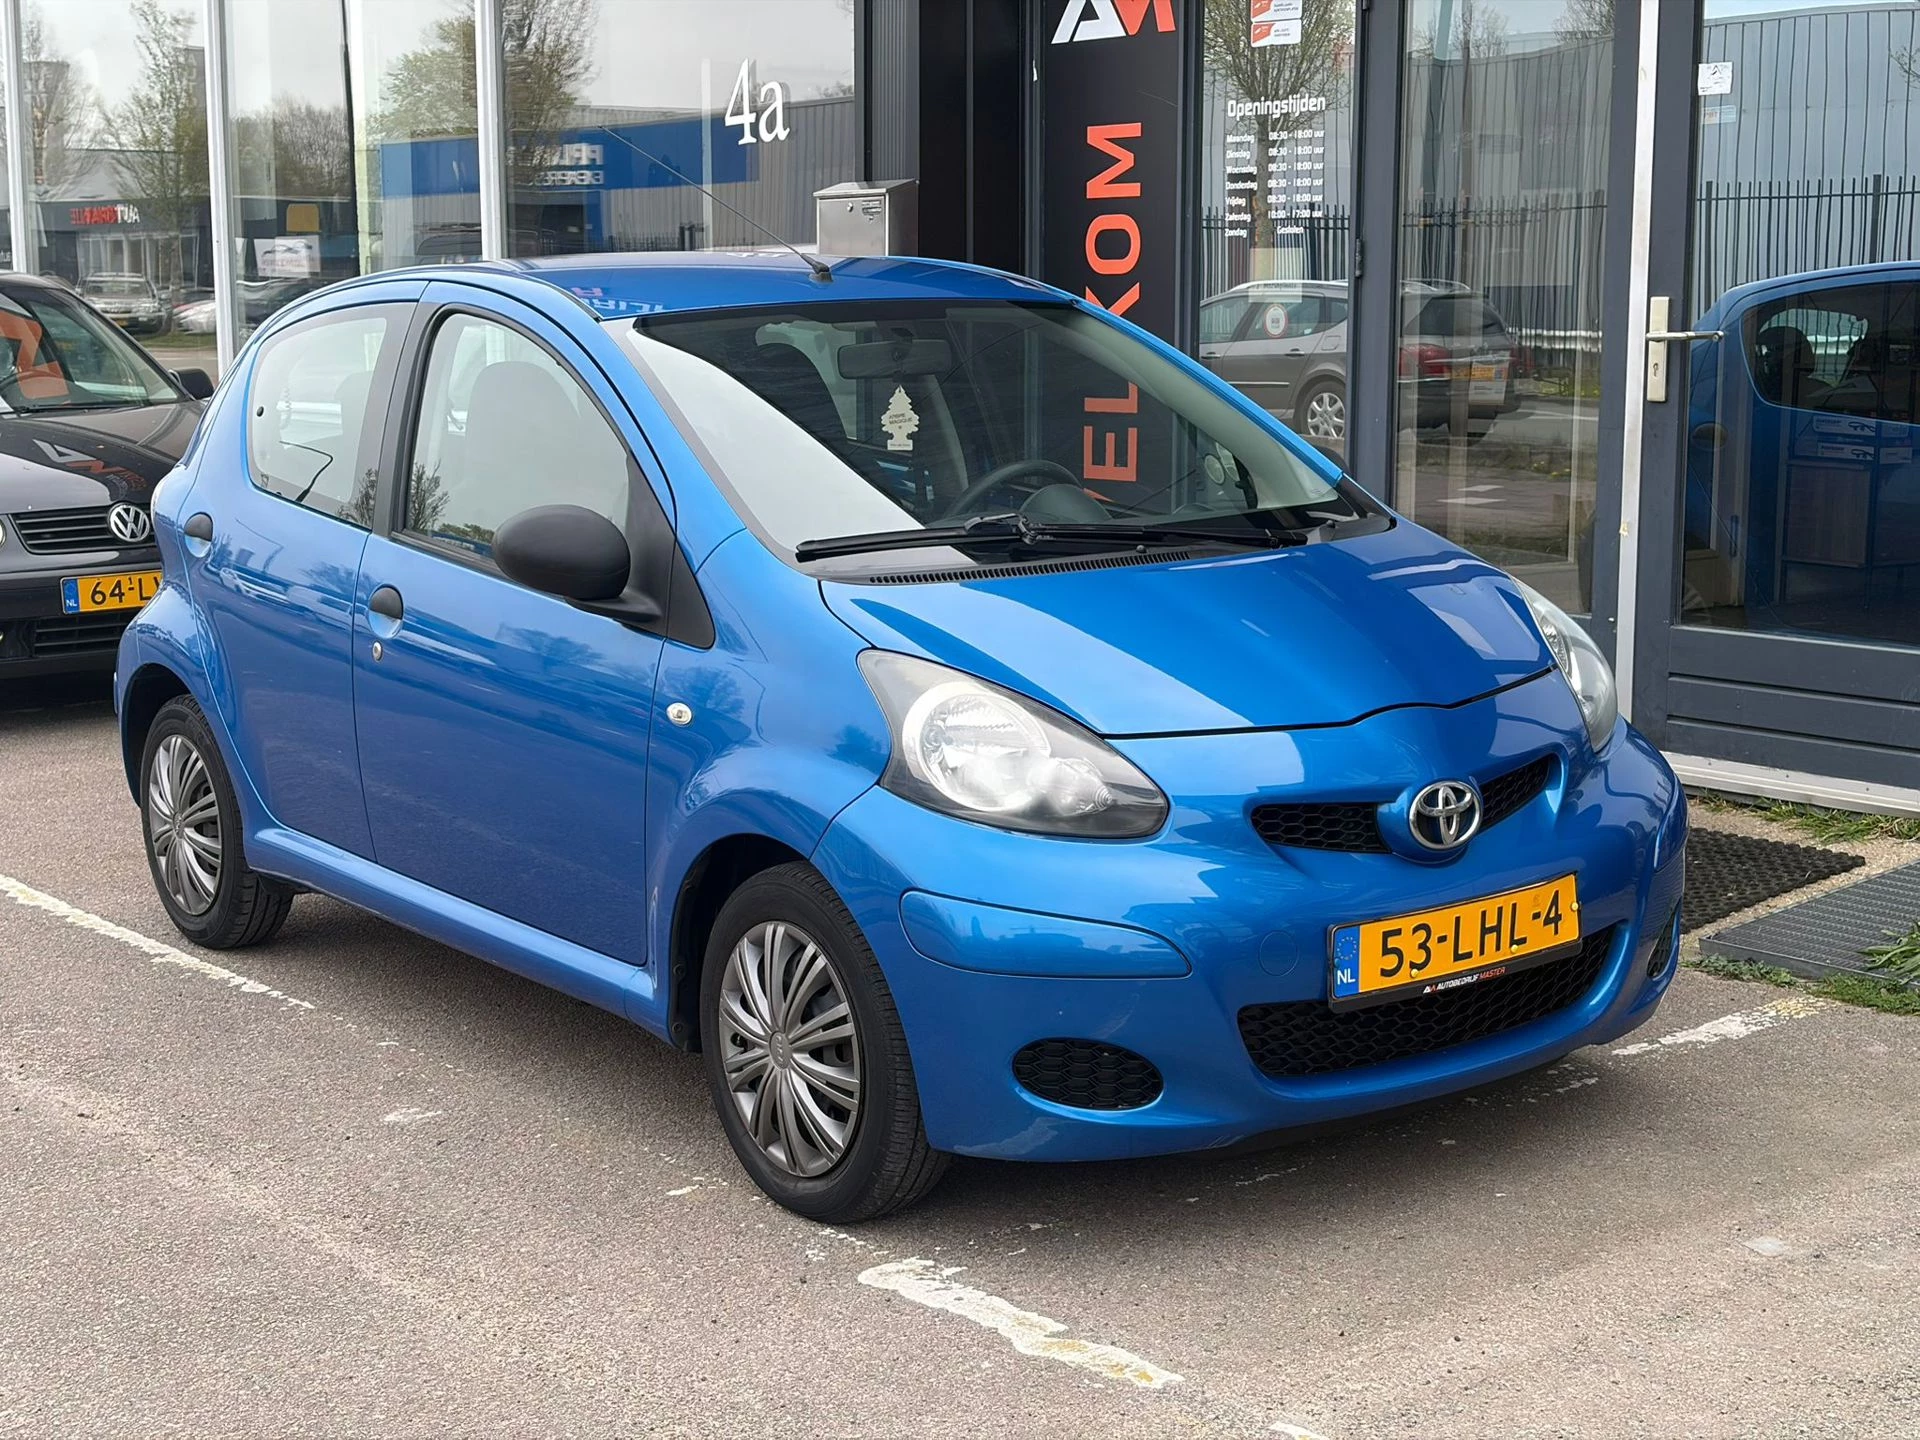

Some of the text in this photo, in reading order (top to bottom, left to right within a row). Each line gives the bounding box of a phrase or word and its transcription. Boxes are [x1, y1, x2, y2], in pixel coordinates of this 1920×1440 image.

[725, 58, 790, 146] 4a
[1227, 93, 1325, 121] Openingstijden
[1226, 133, 1254, 143] Maandag
[1313, 130, 1324, 138] uur
[1226, 150, 1251, 159] Dinsdag
[1226, 165, 1257, 174] Woensdag
[1225, 180, 1258, 190] Donderdag
[1312, 178, 1323, 186] uur
[1225, 196, 1246, 207] Vrijdag
[1312, 194, 1323, 202] uur
[1225, 212, 1251, 222] Zaterdag
[1225, 226, 1304, 238] Zondag Gesloten
[1083, 122, 1143, 502] ELOM
[66, 599, 78, 608] NL
[1380, 890, 1562, 978] 53-LHL-4
[1336, 968, 1356, 985] NL
[1436, 974, 1480, 990] AUTOBEDRIJF
[1479, 966, 1506, 979] MASTER
